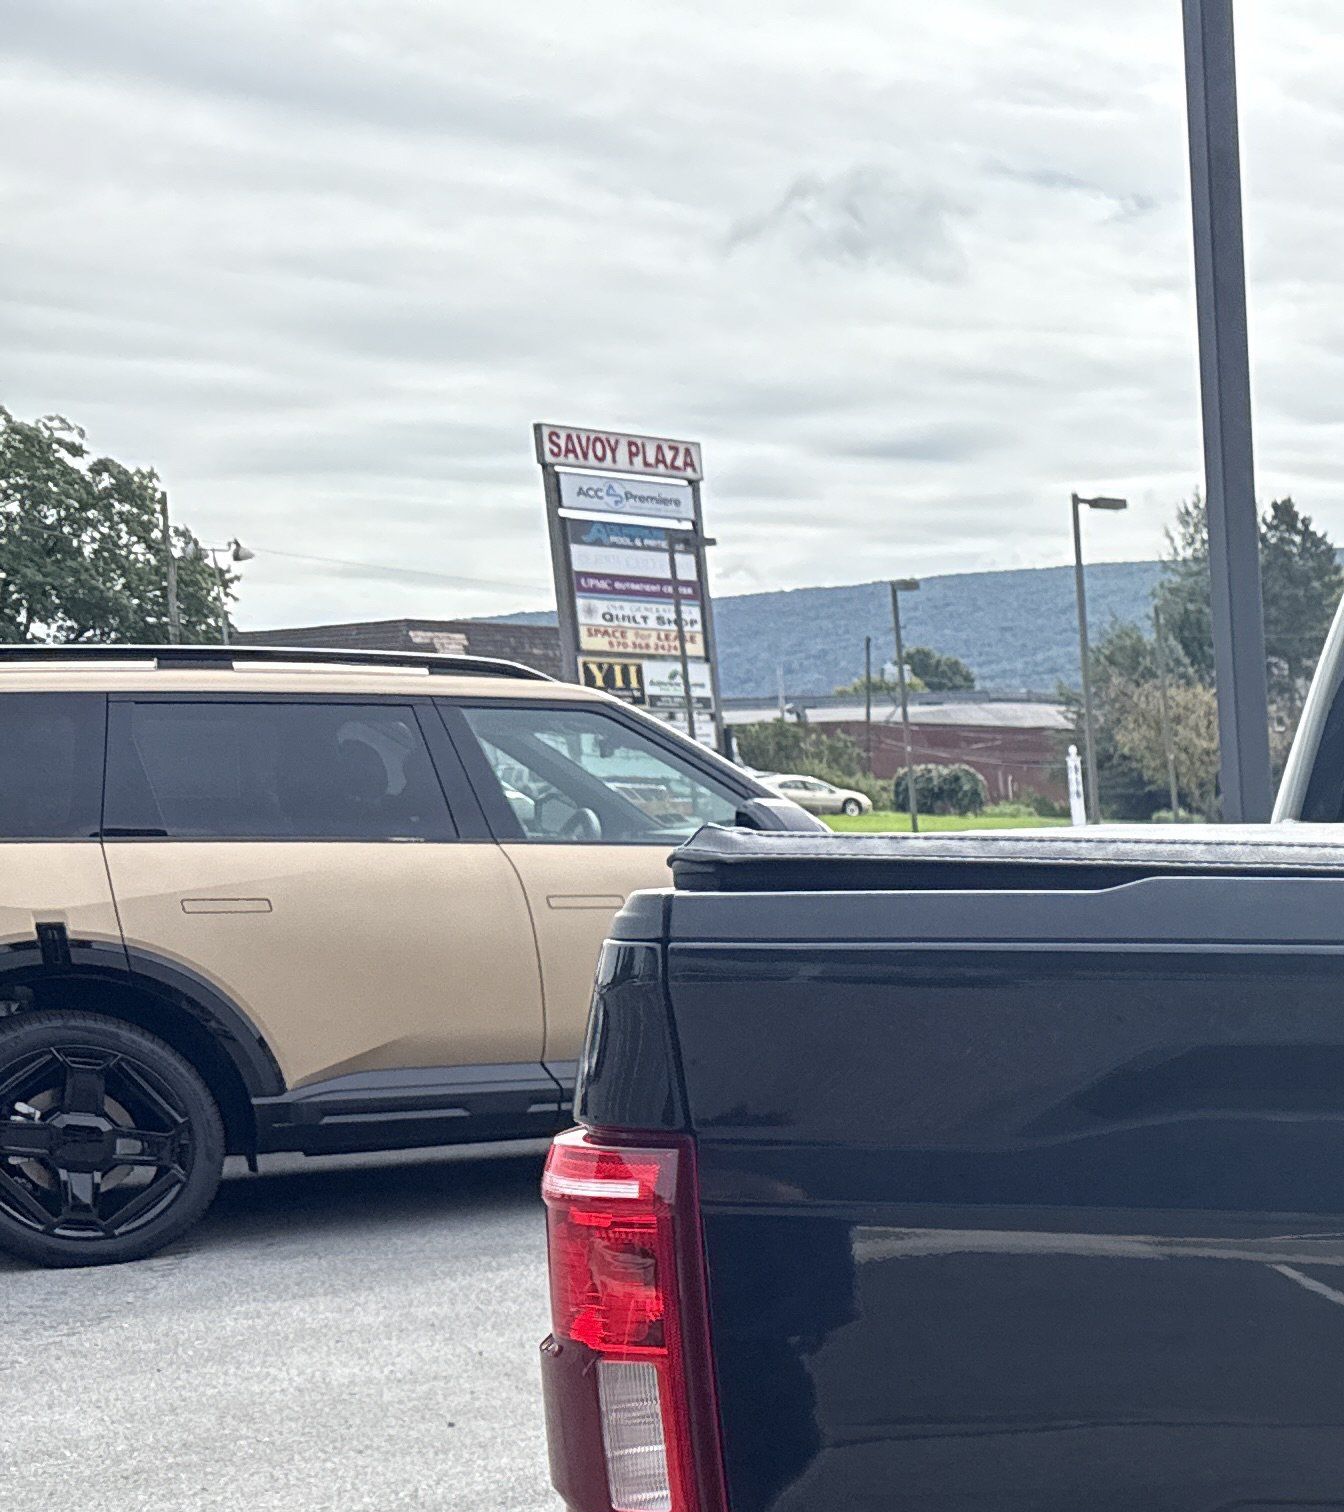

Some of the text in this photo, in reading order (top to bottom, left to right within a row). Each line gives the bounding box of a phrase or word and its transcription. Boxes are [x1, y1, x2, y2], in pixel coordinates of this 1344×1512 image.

[548, 431, 698, 473] SAVOY PLAZA
[576, 486, 604, 500] ACC
[587, 628, 628, 639] SPACE
